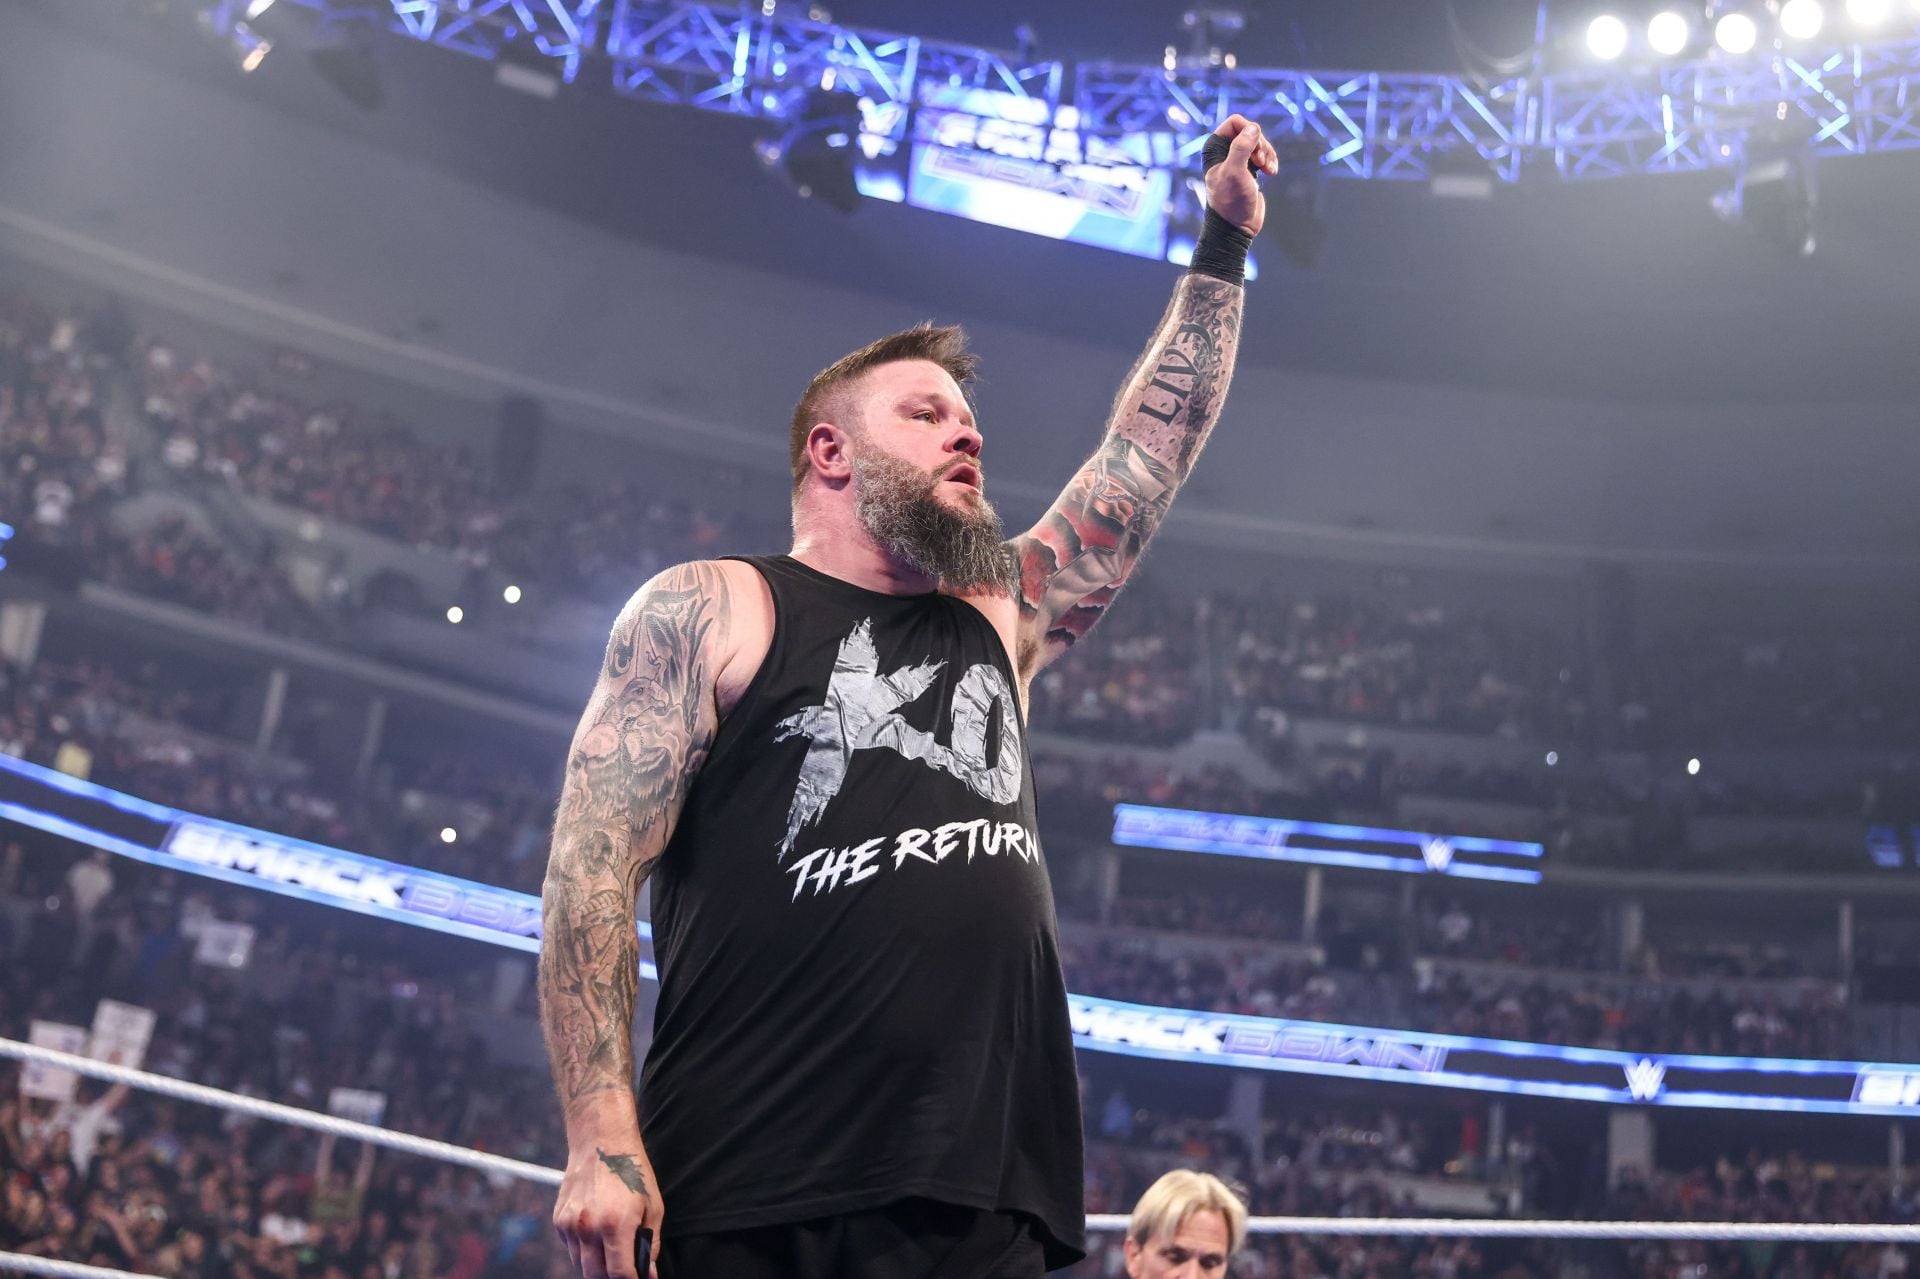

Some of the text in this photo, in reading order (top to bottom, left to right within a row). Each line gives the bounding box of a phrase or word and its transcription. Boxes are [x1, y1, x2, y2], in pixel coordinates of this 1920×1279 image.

[1137, 322, 1214, 427] LIVE
[773, 616, 1023, 865] KO
[785, 818, 1040, 903] THE RETURN
